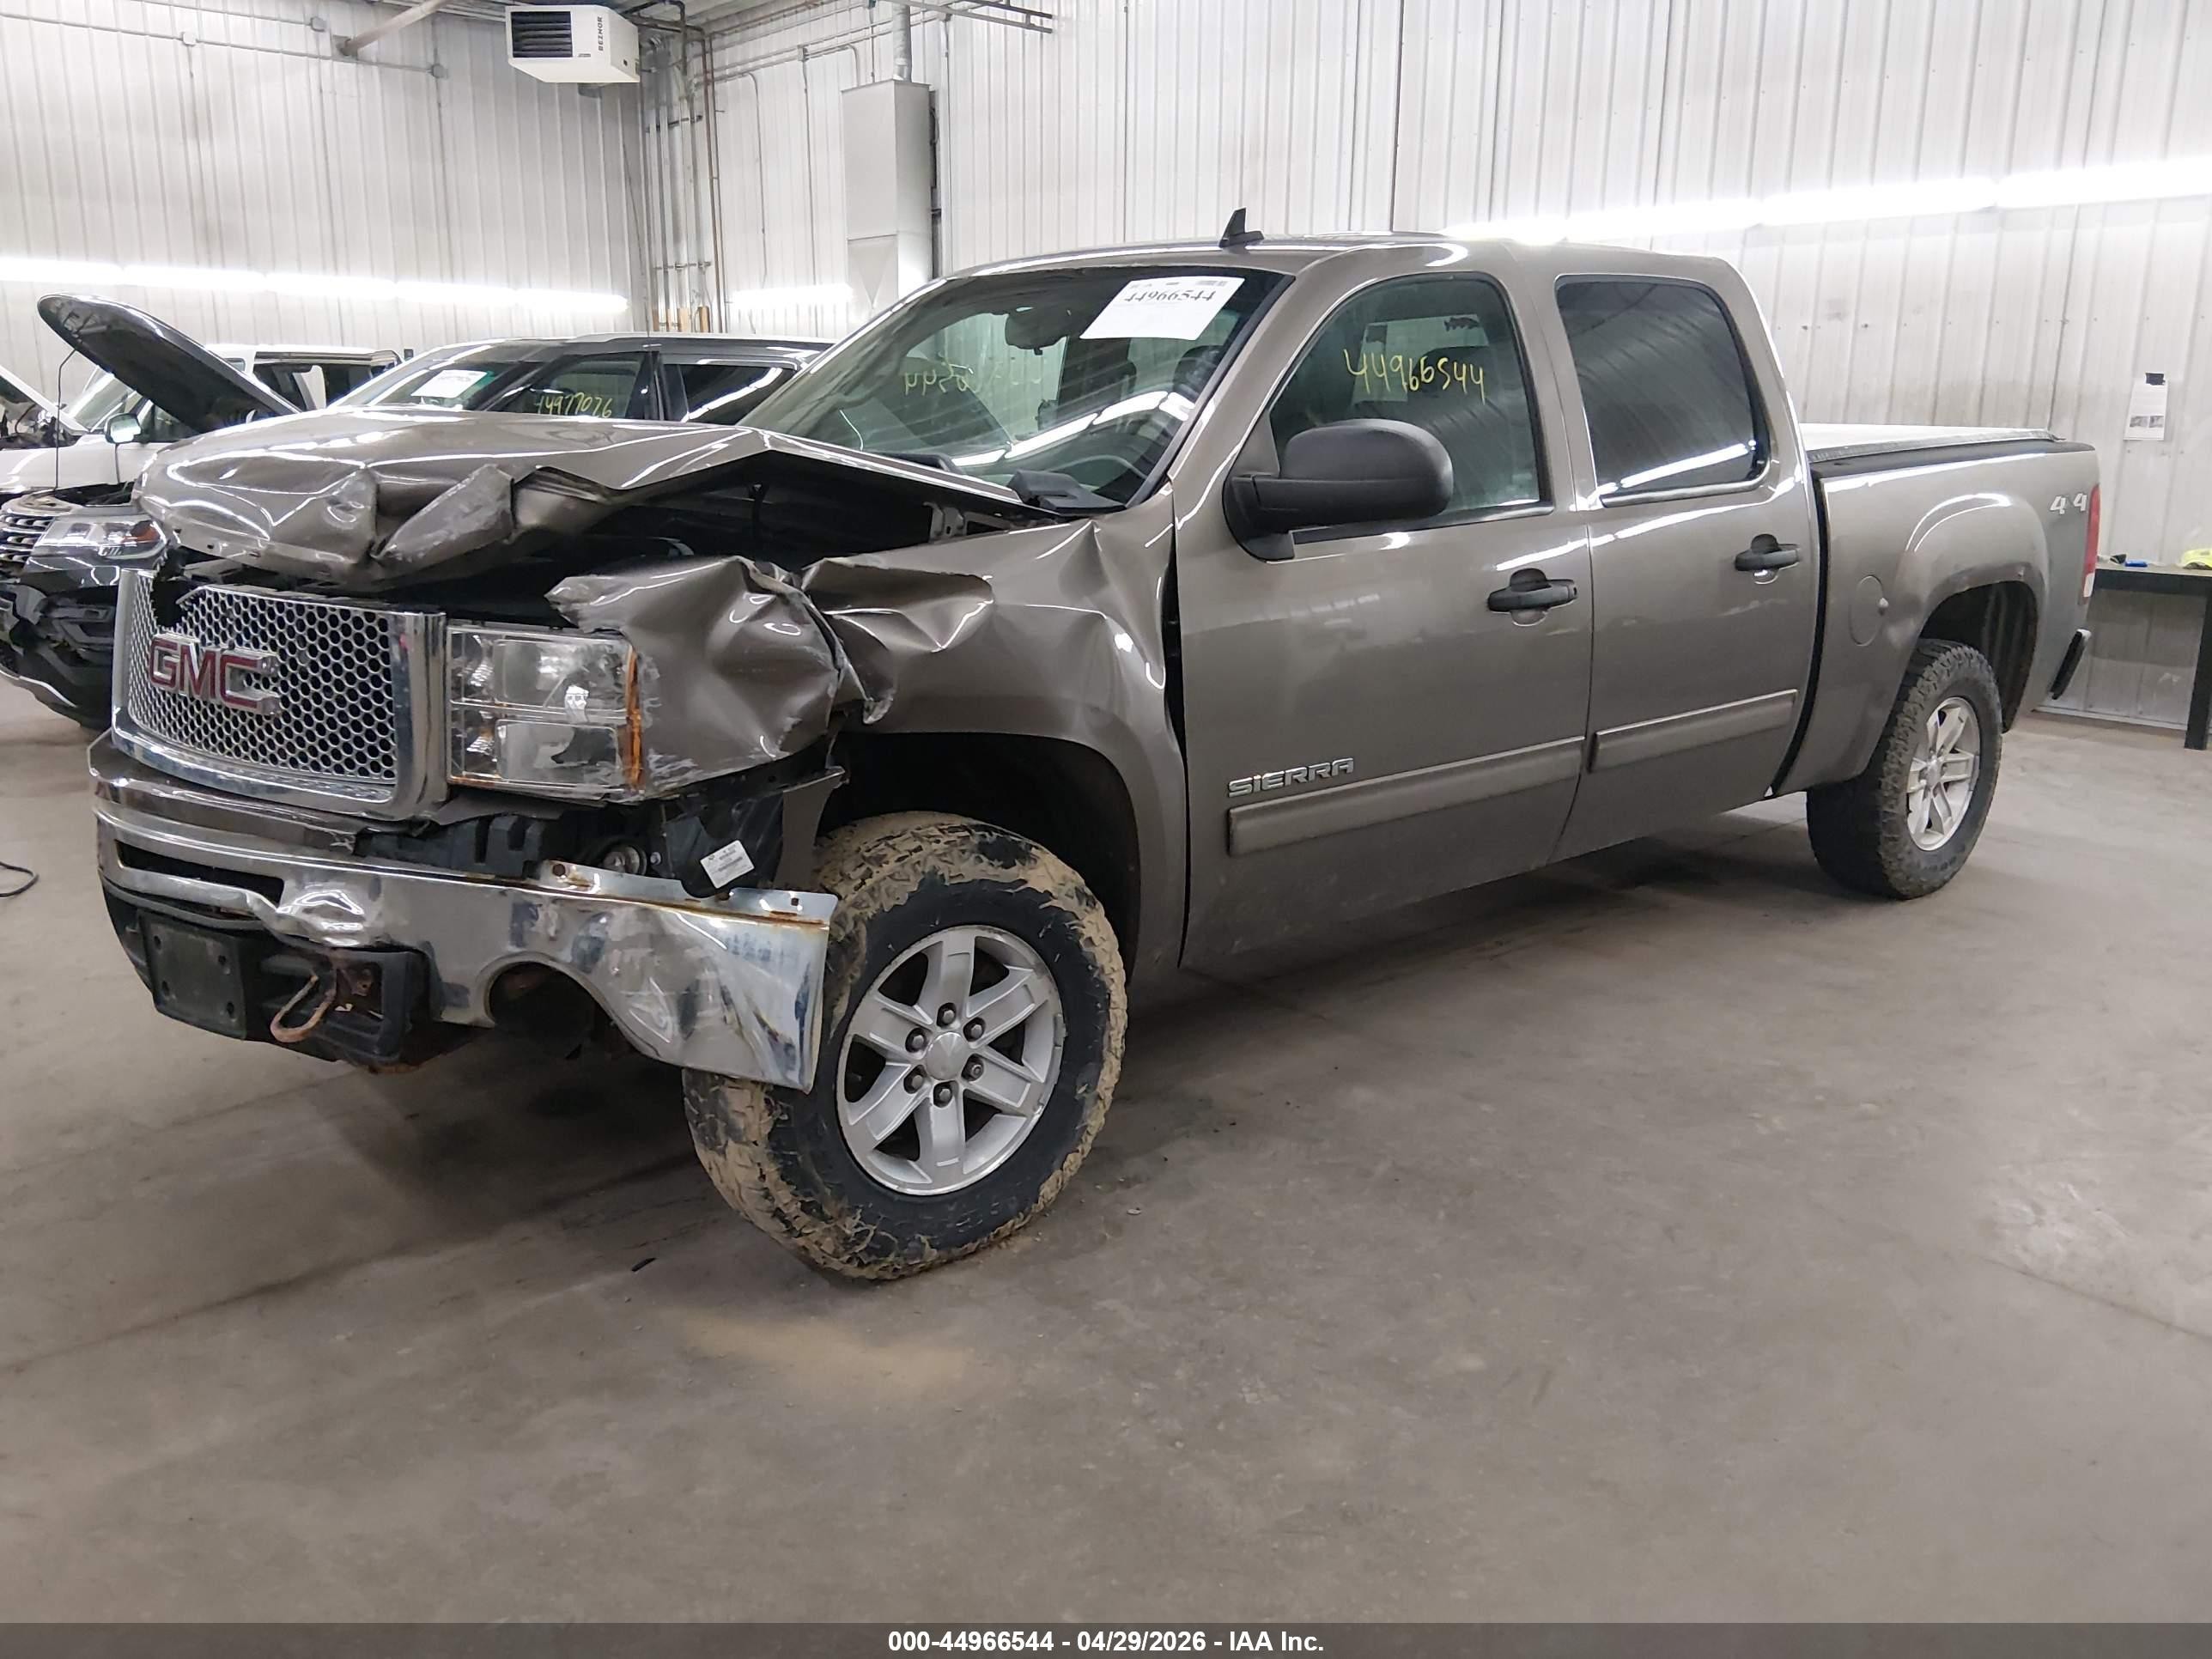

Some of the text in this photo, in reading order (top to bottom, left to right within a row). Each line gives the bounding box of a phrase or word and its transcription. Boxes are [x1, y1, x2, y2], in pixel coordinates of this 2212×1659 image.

[1124, 289, 1216, 301] 44966544
[1343, 349, 1486, 405] 44966544
[149, 633, 280, 716] GMC
[1228, 757, 1354, 798] SIERRA
